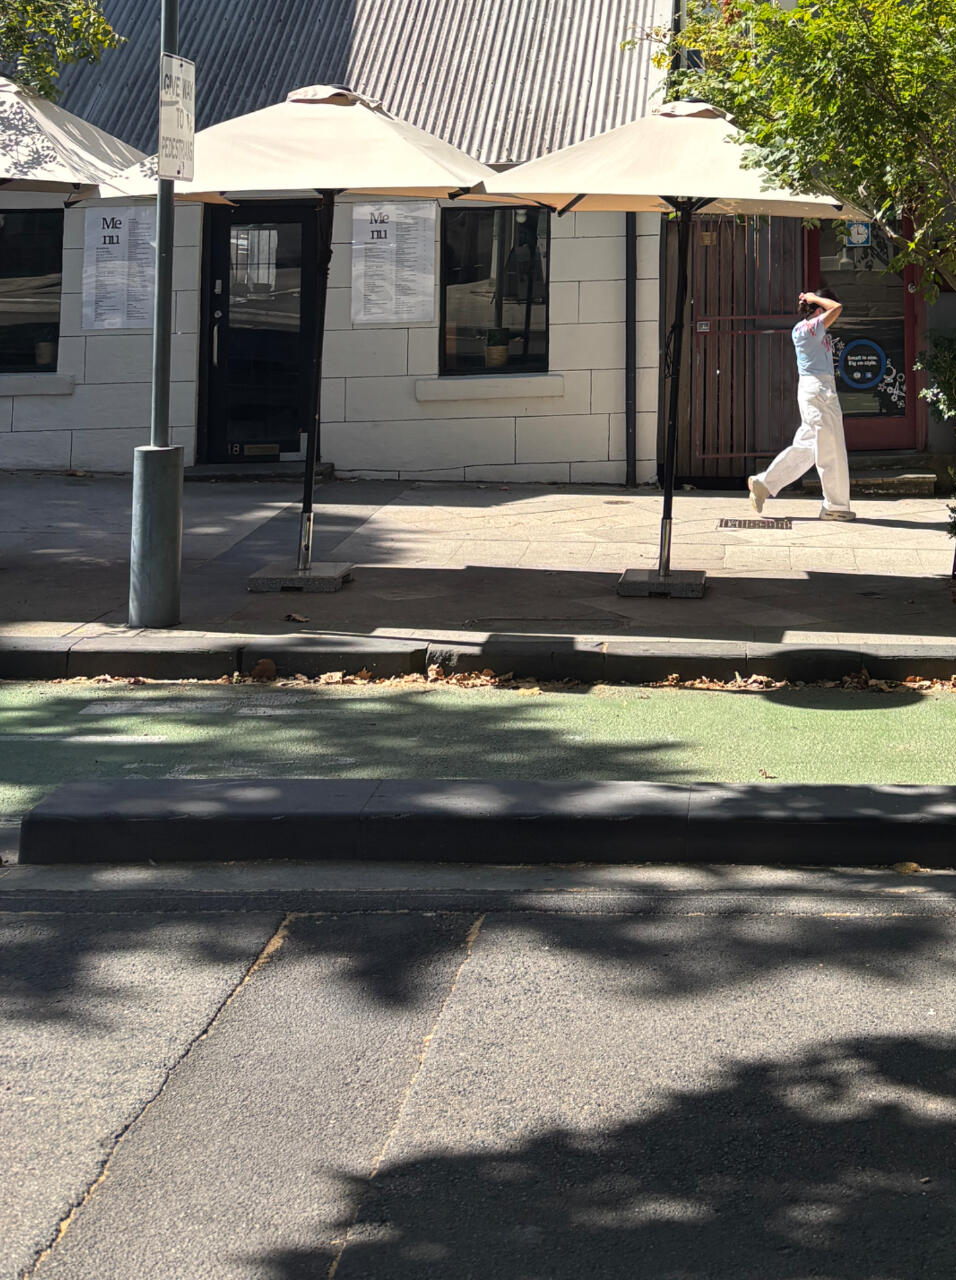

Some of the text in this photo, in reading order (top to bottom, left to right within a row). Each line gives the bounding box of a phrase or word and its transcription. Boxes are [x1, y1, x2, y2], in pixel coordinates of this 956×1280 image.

[164, 73, 194, 101] GIVE WAY
[176, 107, 184, 129] TO
[102, 217, 122, 230] Me
[369, 212, 389, 224] Me
[103, 235, 121, 245] nu
[371, 229, 388, 240] nu
[228, 443, 240, 456] 18
